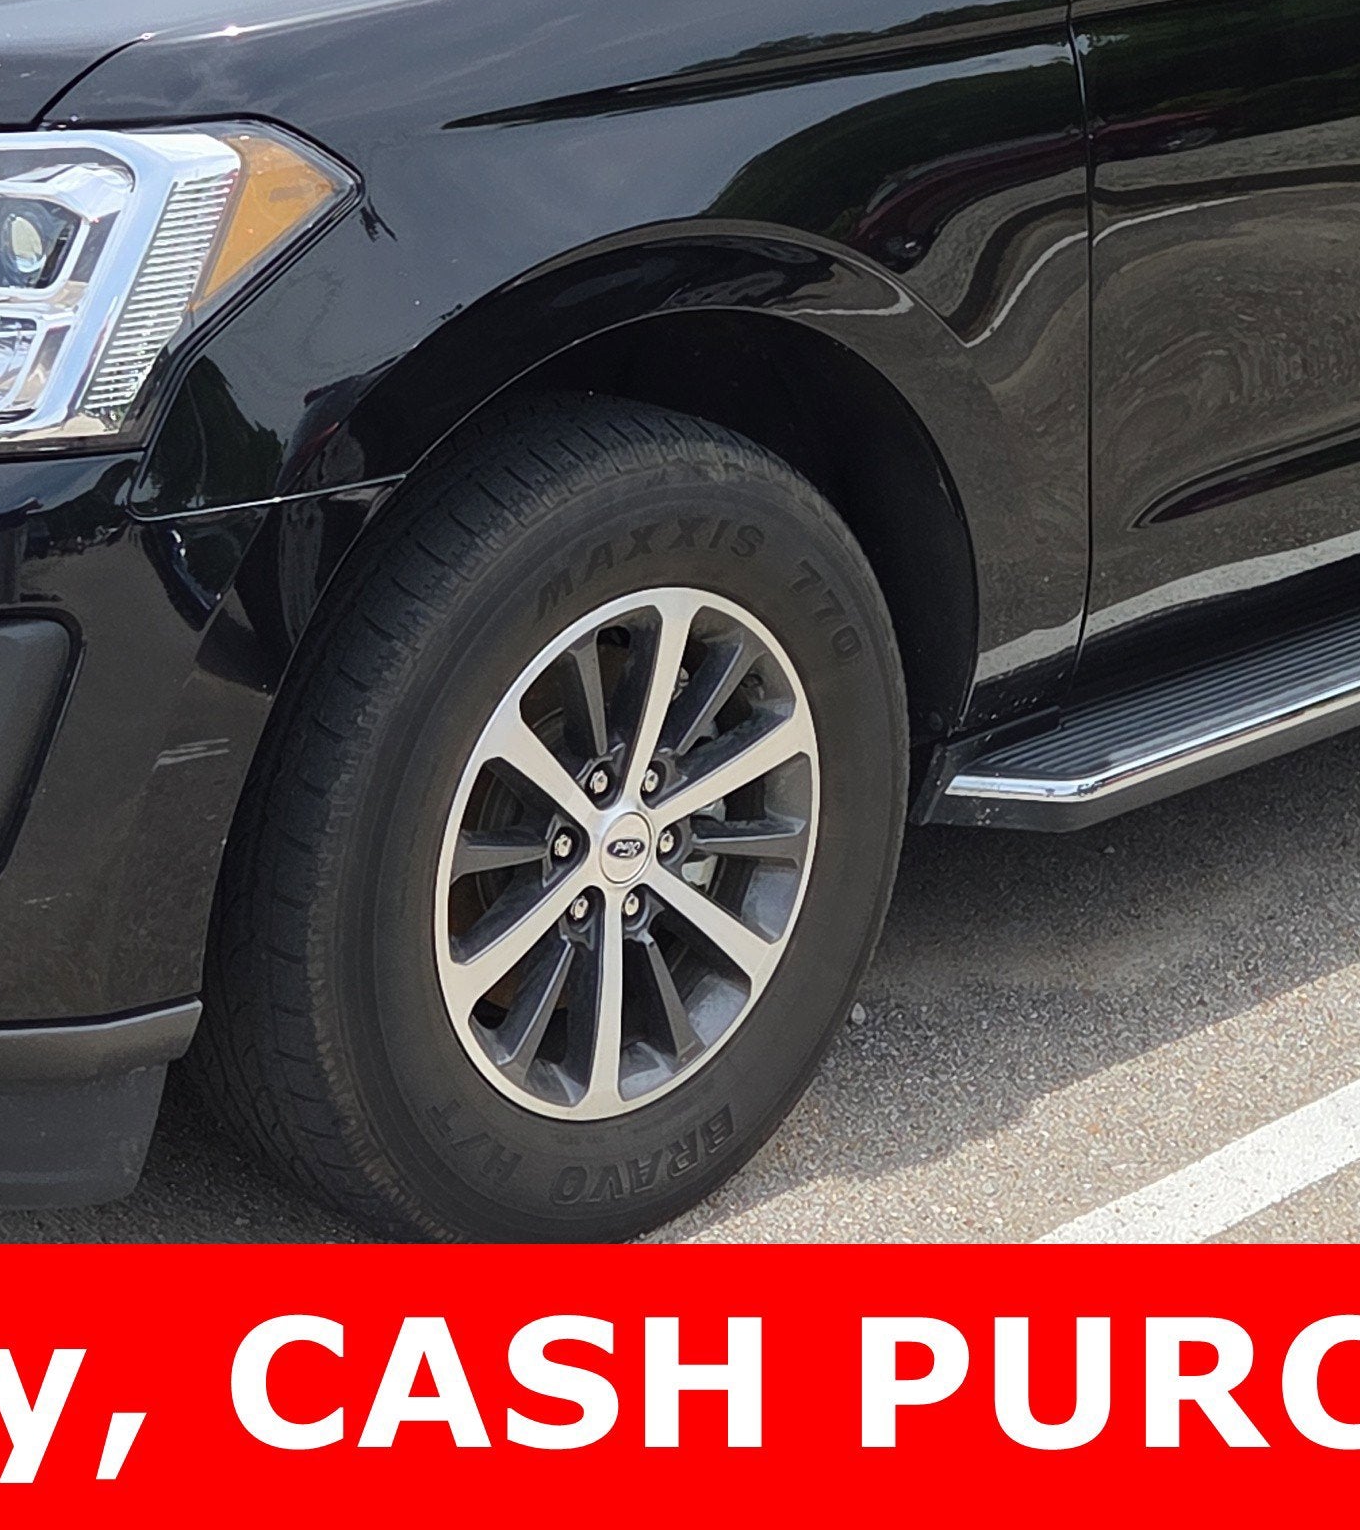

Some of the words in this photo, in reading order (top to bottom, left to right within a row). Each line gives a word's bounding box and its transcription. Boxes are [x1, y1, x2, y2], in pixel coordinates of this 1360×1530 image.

[538, 518, 766, 614] MAXXIS
[789, 560, 863, 660] 770
[424, 1099, 522, 1183] H/T
[549, 1103, 735, 1205] BRAVO
